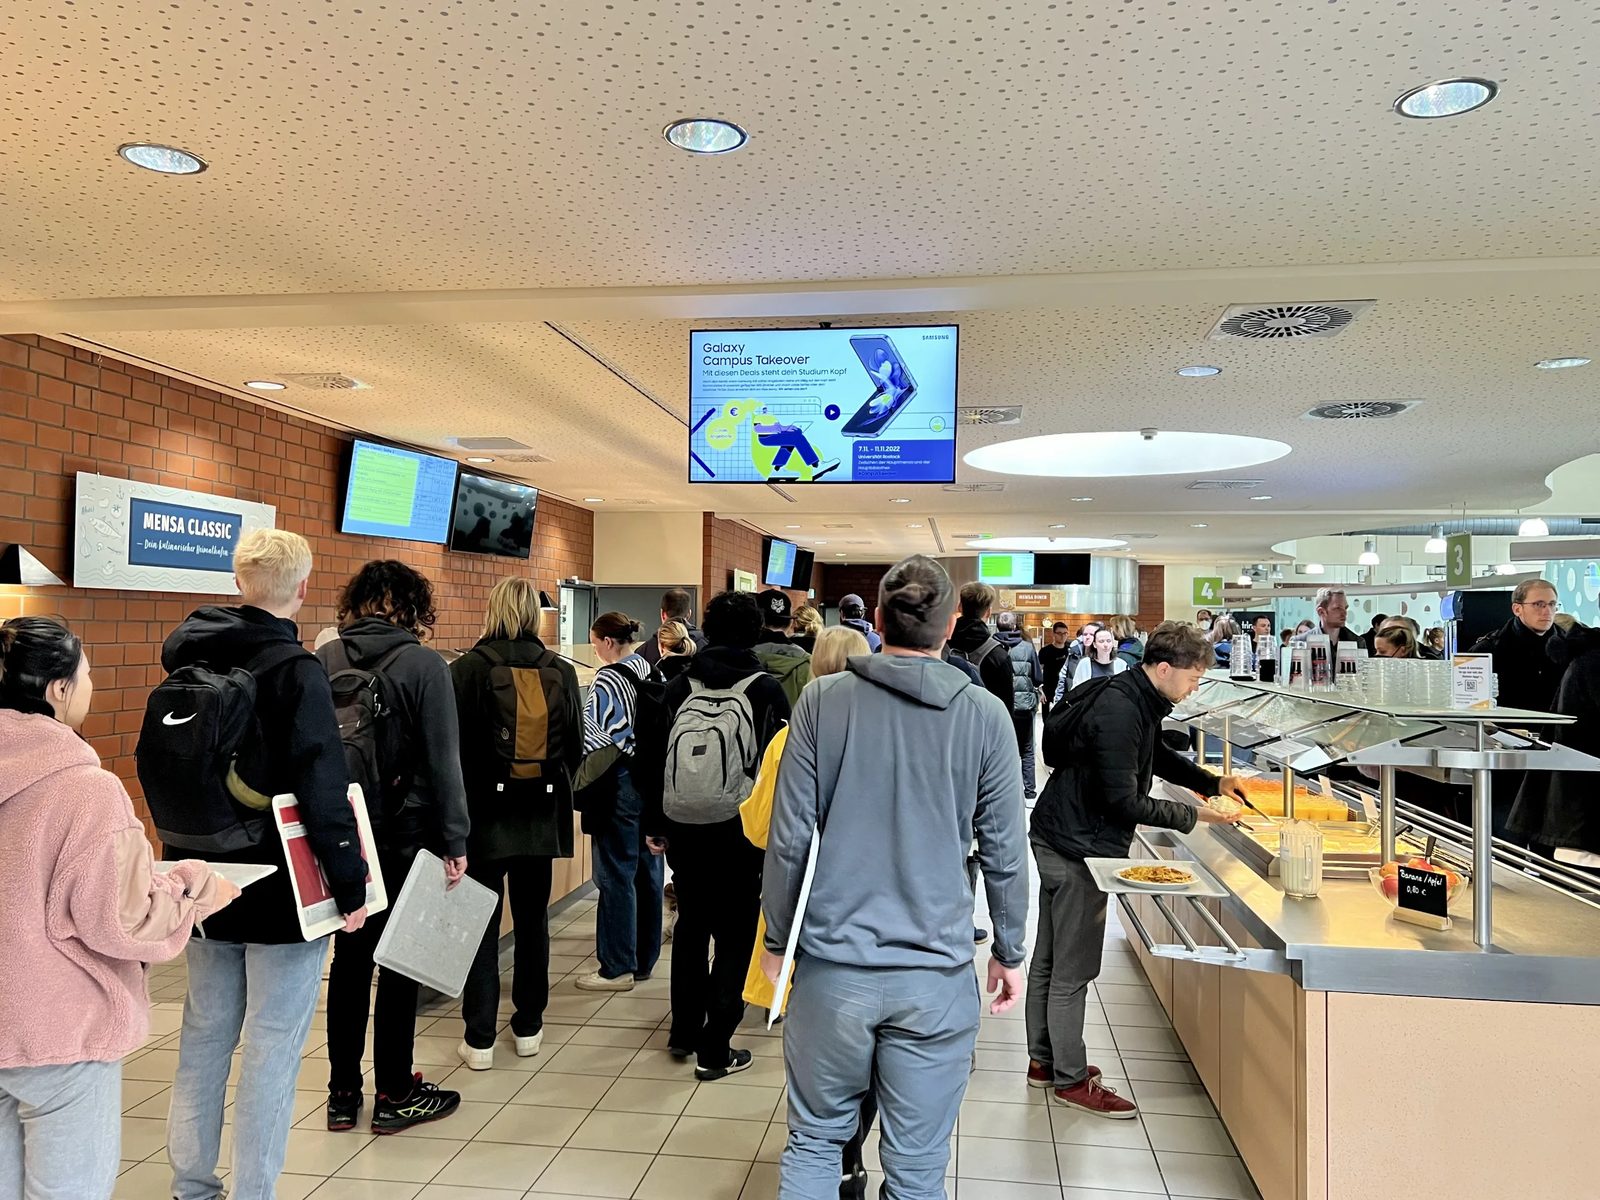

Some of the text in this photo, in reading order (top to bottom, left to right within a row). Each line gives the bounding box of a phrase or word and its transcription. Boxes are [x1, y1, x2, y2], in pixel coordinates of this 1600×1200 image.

[702, 342, 746, 355] Galaxy
[702, 354, 810, 369] Campus Takeover
[702, 369, 713, 377] Mit
[714, 369, 739, 377] diesen
[739, 369, 760, 377] Deals
[760, 368, 780, 377] steht
[781, 368, 798, 377] dein
[798, 368, 829, 376] Studium
[143, 512, 232, 540] MENSA CLASSIC
[144, 539, 157, 550] Dein
[1454, 544, 1464, 576] 3
[1201, 582, 1214, 600] 4
[1399, 869, 1423, 882] Banane
[1406, 885, 1420, 894] 0,80
